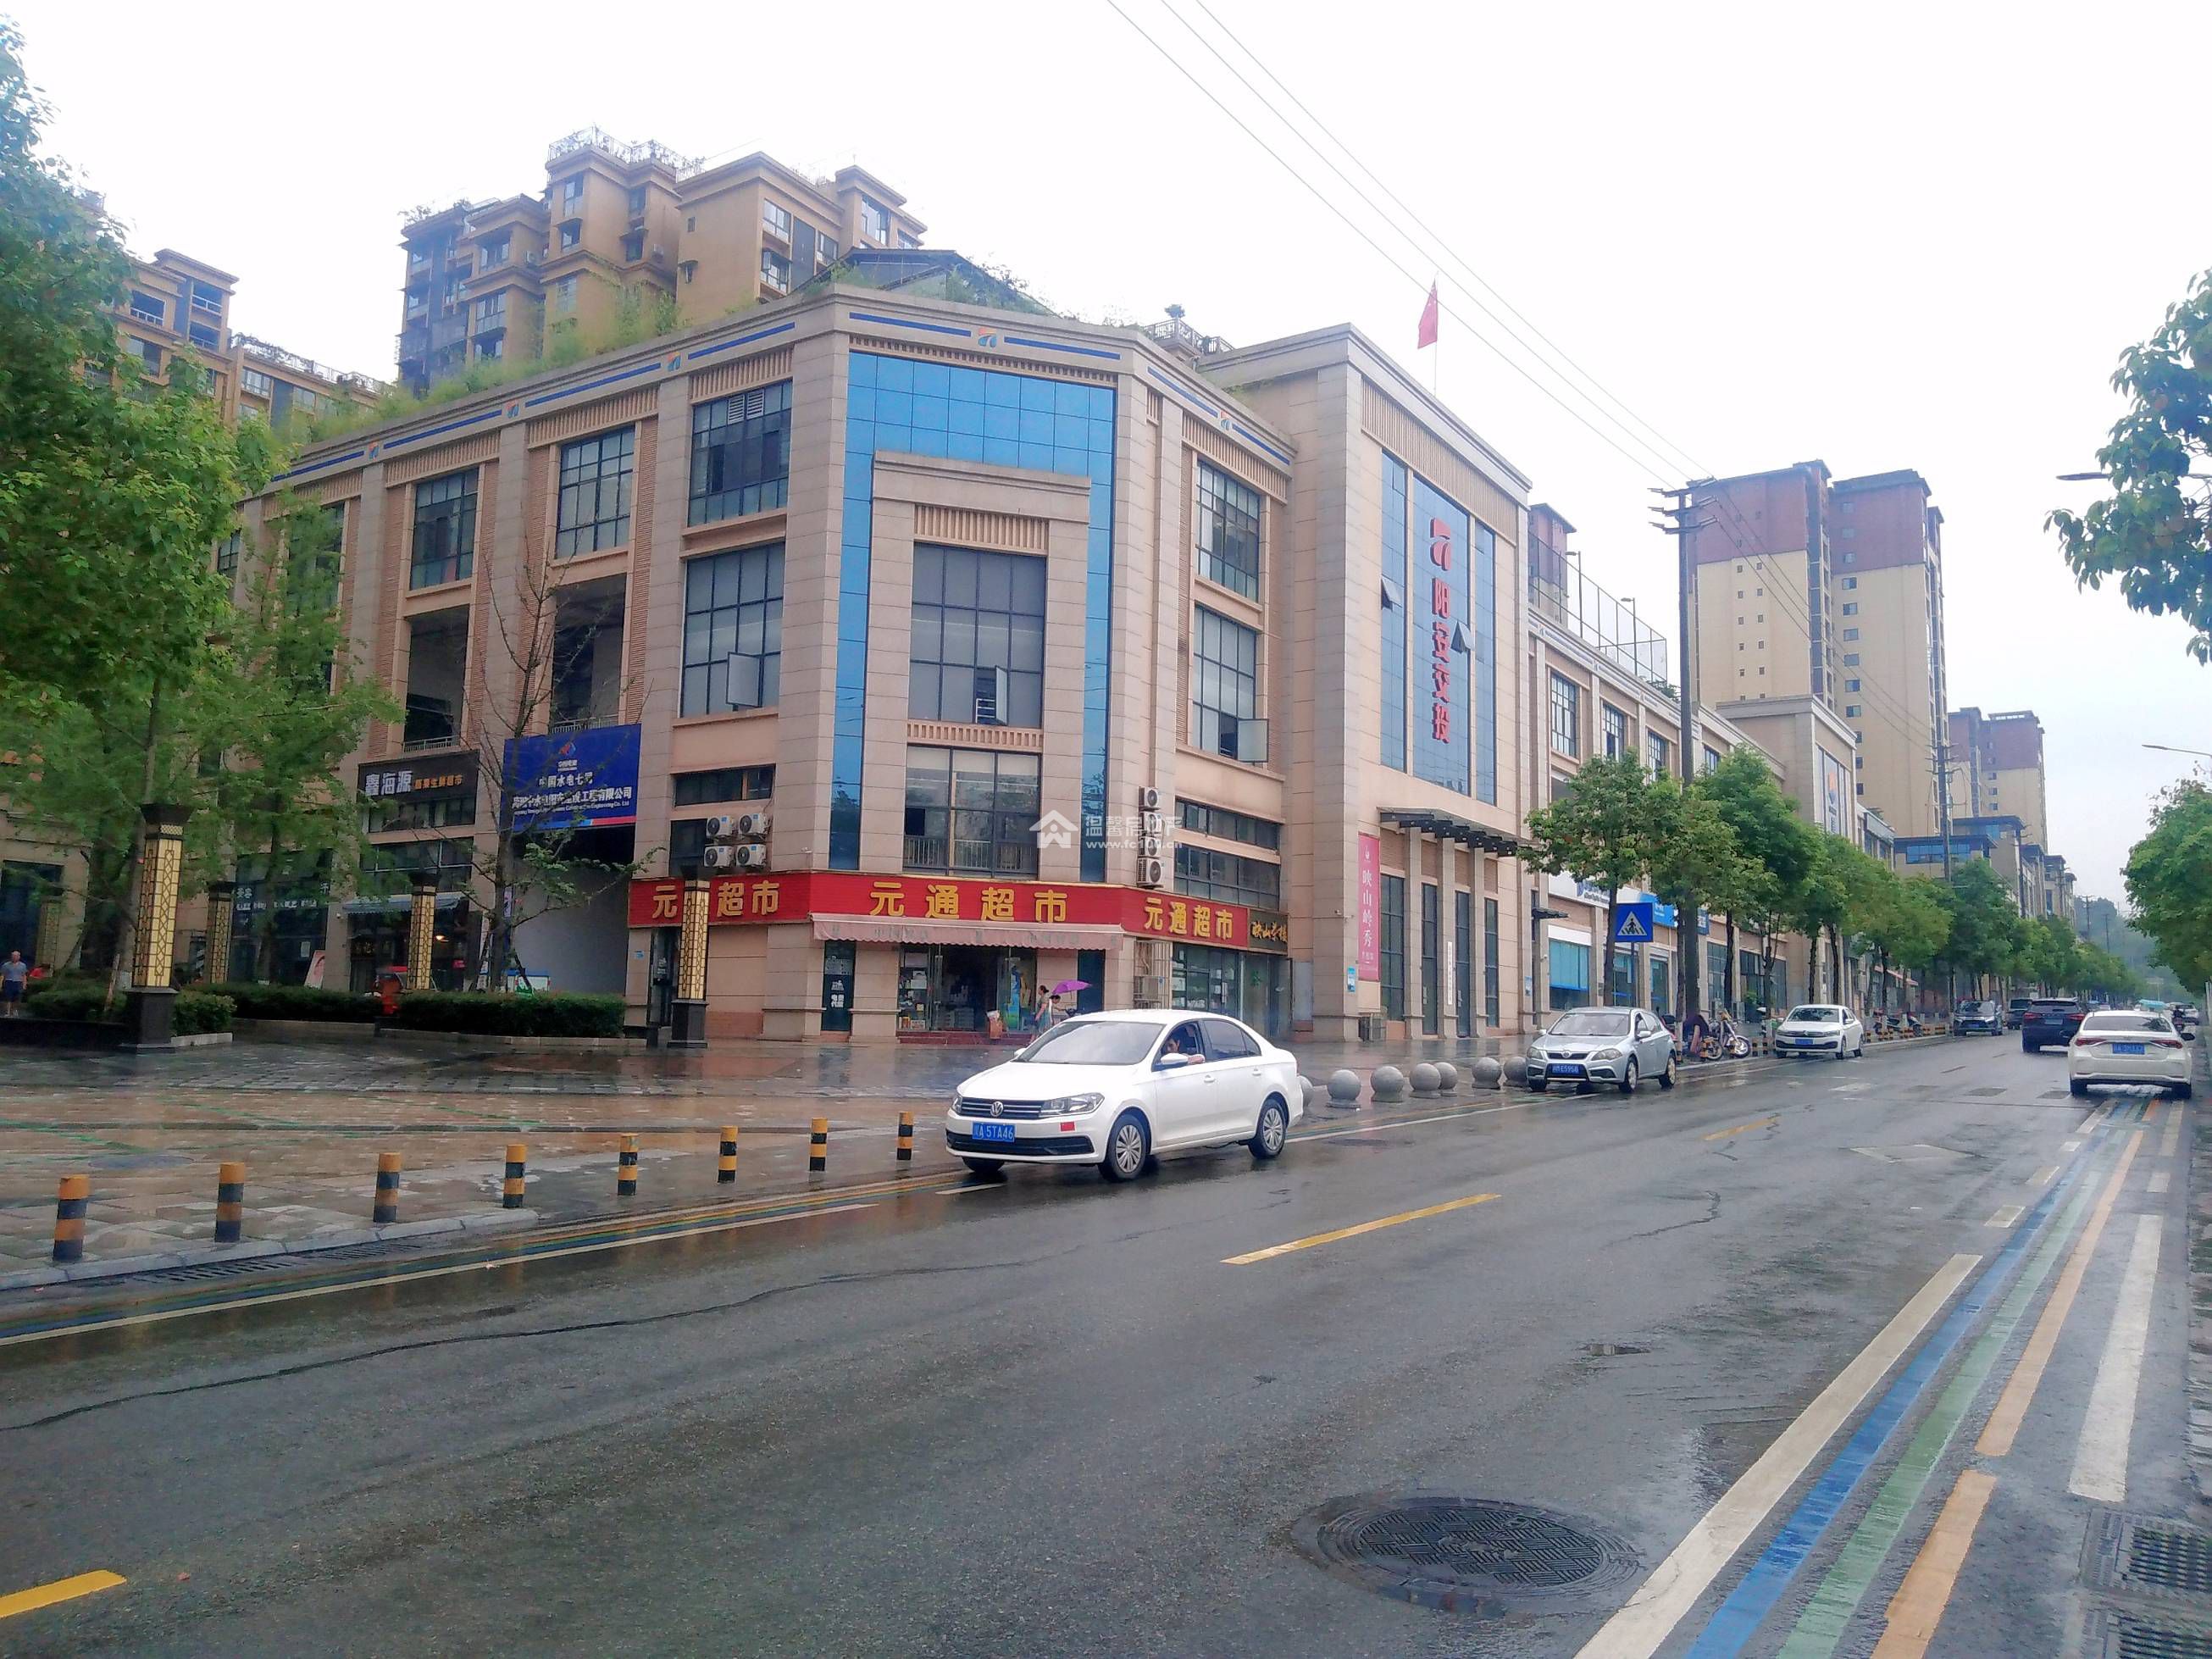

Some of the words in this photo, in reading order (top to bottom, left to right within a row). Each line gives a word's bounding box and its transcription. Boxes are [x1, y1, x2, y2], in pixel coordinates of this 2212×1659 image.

[1432, 577, 1450, 744] 阳安交投
[651, 879, 780, 919] 元超市
[869, 881, 1068, 924] 元通超市
[1144, 896, 1234, 940] 元通超市
